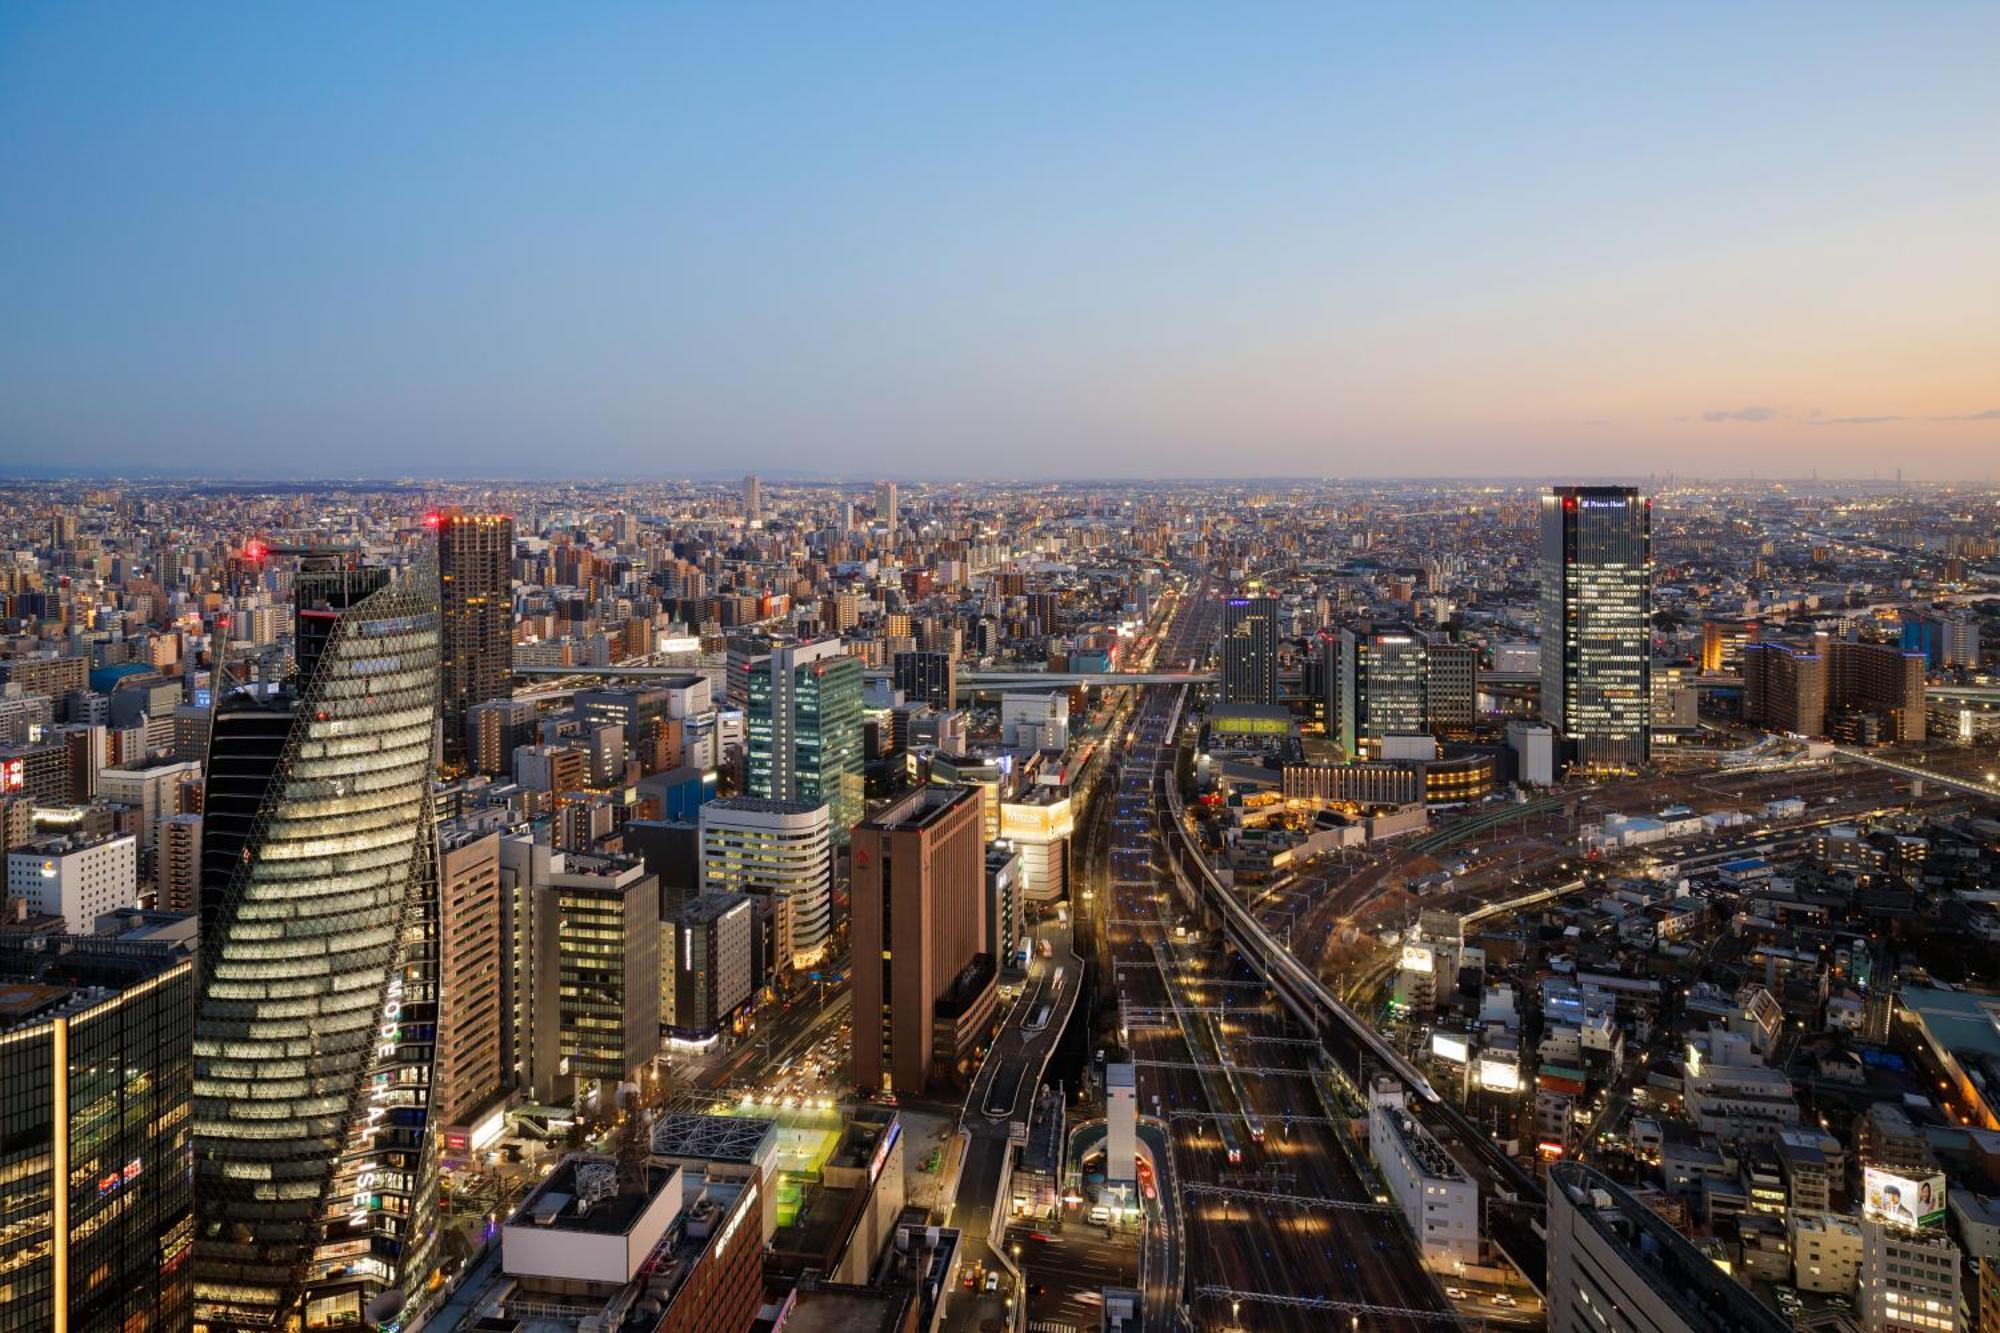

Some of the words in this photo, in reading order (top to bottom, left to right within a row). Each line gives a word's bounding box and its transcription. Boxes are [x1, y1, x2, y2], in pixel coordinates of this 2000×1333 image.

[378, 979, 400, 1057] MODE
[362, 1084, 389, 1142] HAL
[350, 1162, 377, 1227] ISEN
